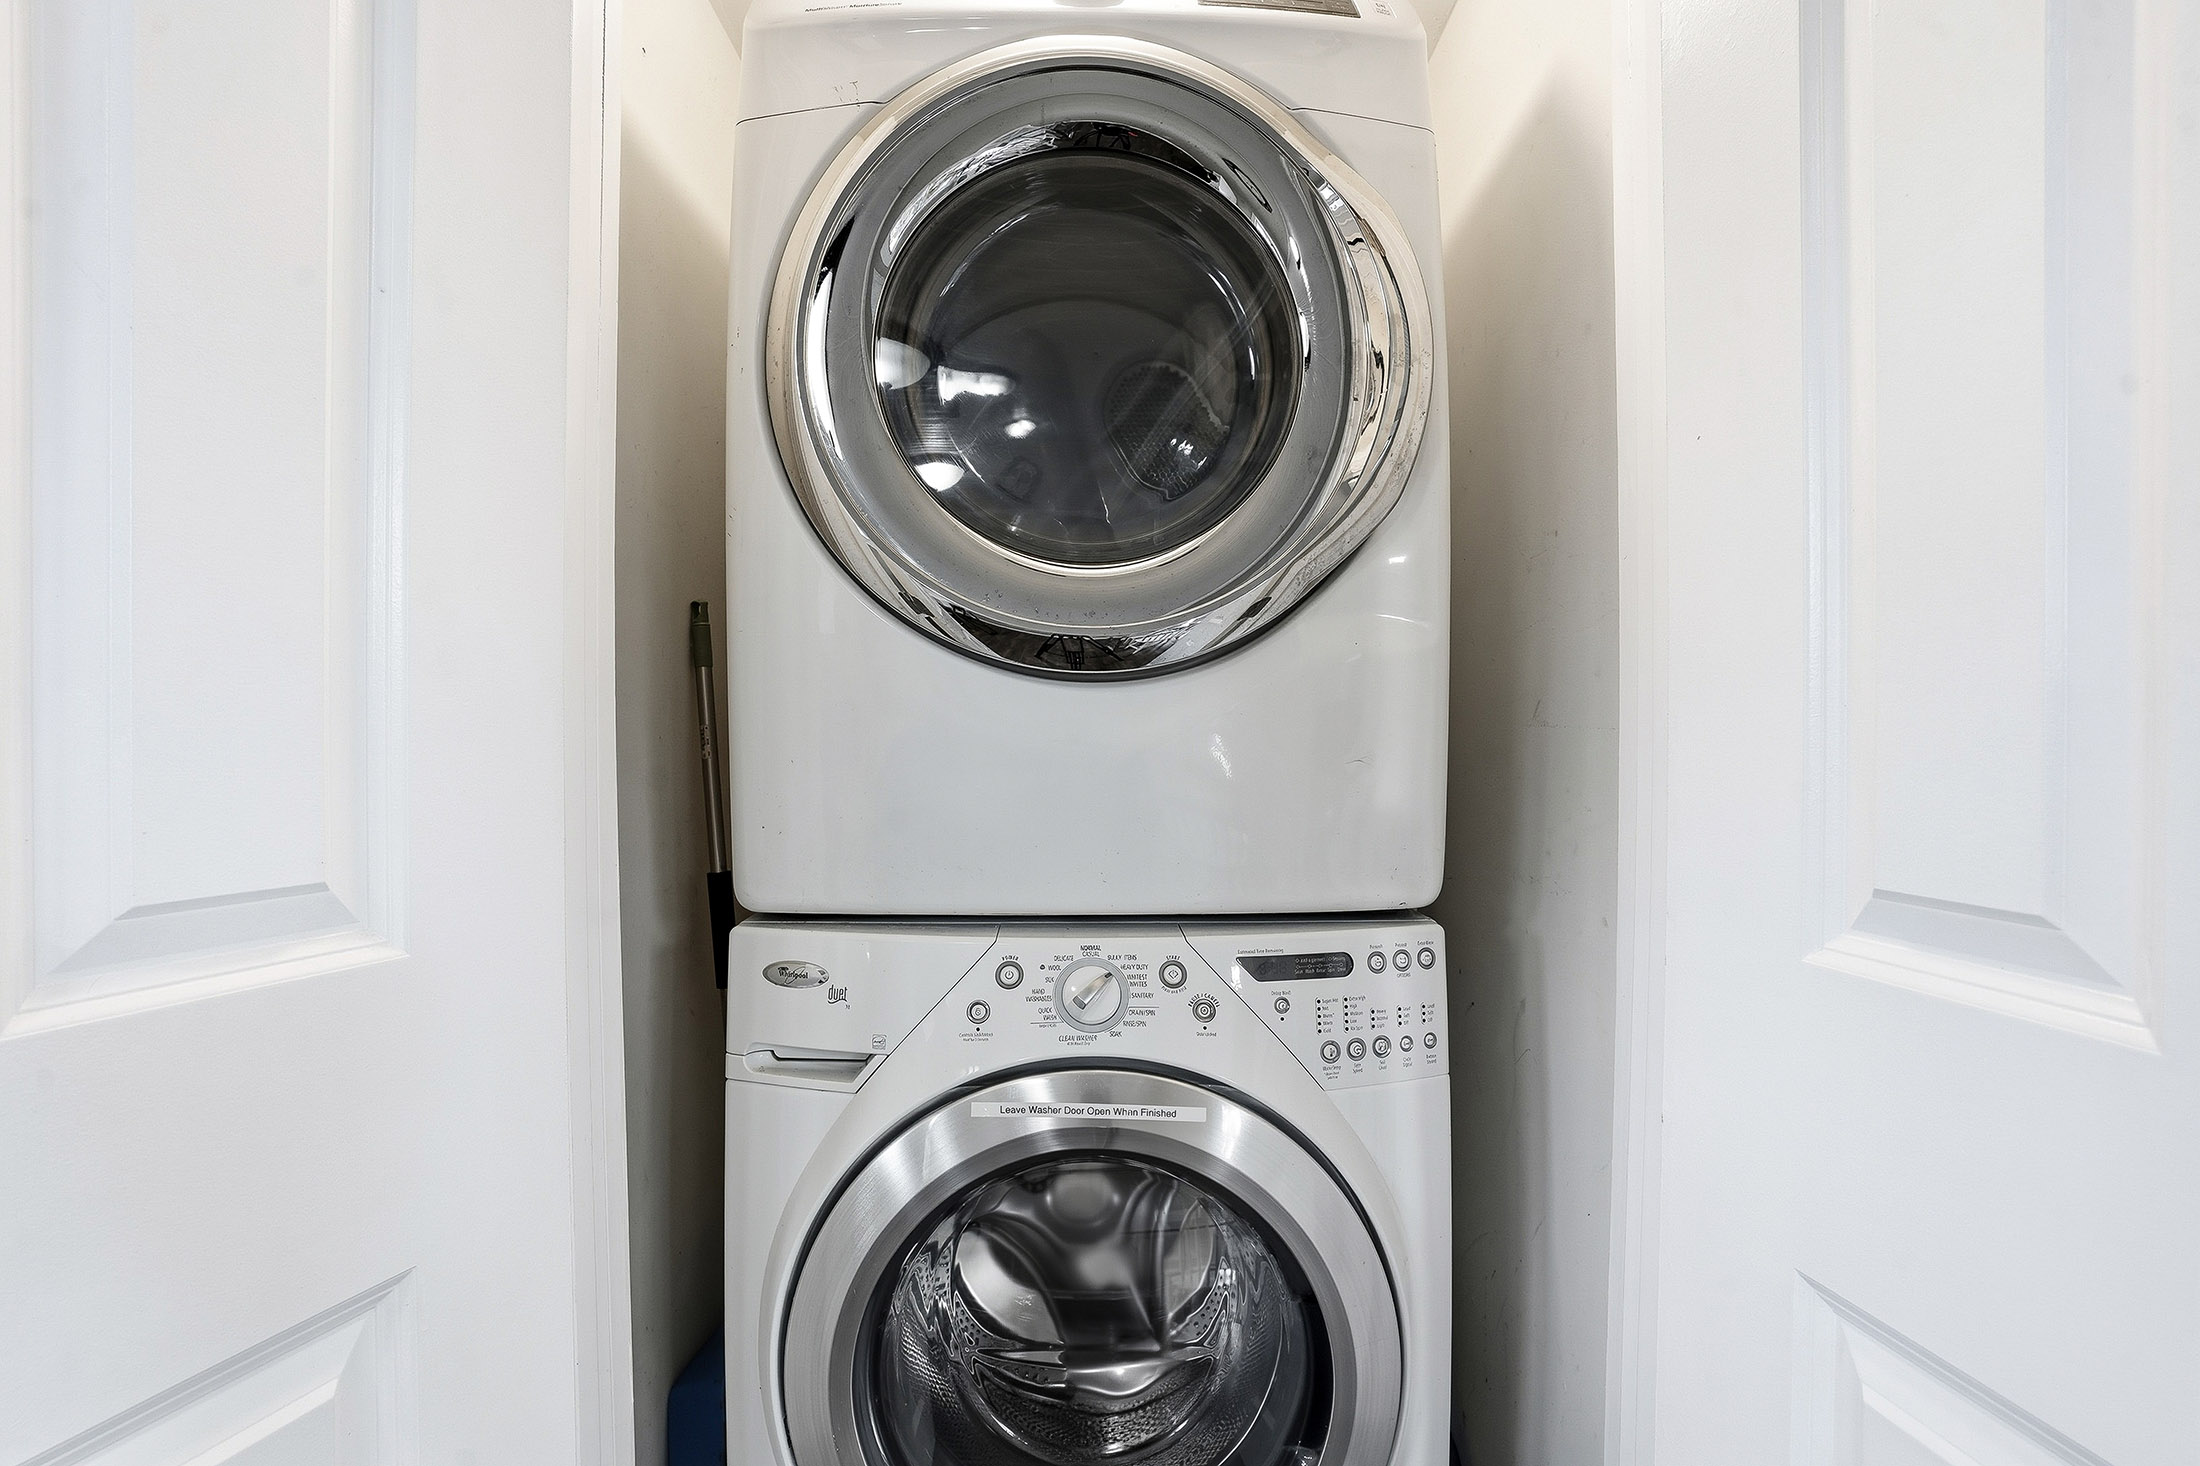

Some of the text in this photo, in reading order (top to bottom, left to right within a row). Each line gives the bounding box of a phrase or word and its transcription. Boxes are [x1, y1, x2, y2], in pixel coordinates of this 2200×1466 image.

[777, 966, 809, 981] Whirlpool
[828, 985, 849, 1001] duet
[1000, 1105, 1026, 1114] Leave
[1028, 1105, 1062, 1114] Washer
[1064, 1106, 1085, 1115] Door
[1087, 1106, 1111, 1117] Open
[1140, 1108, 1177, 1118] Finished
